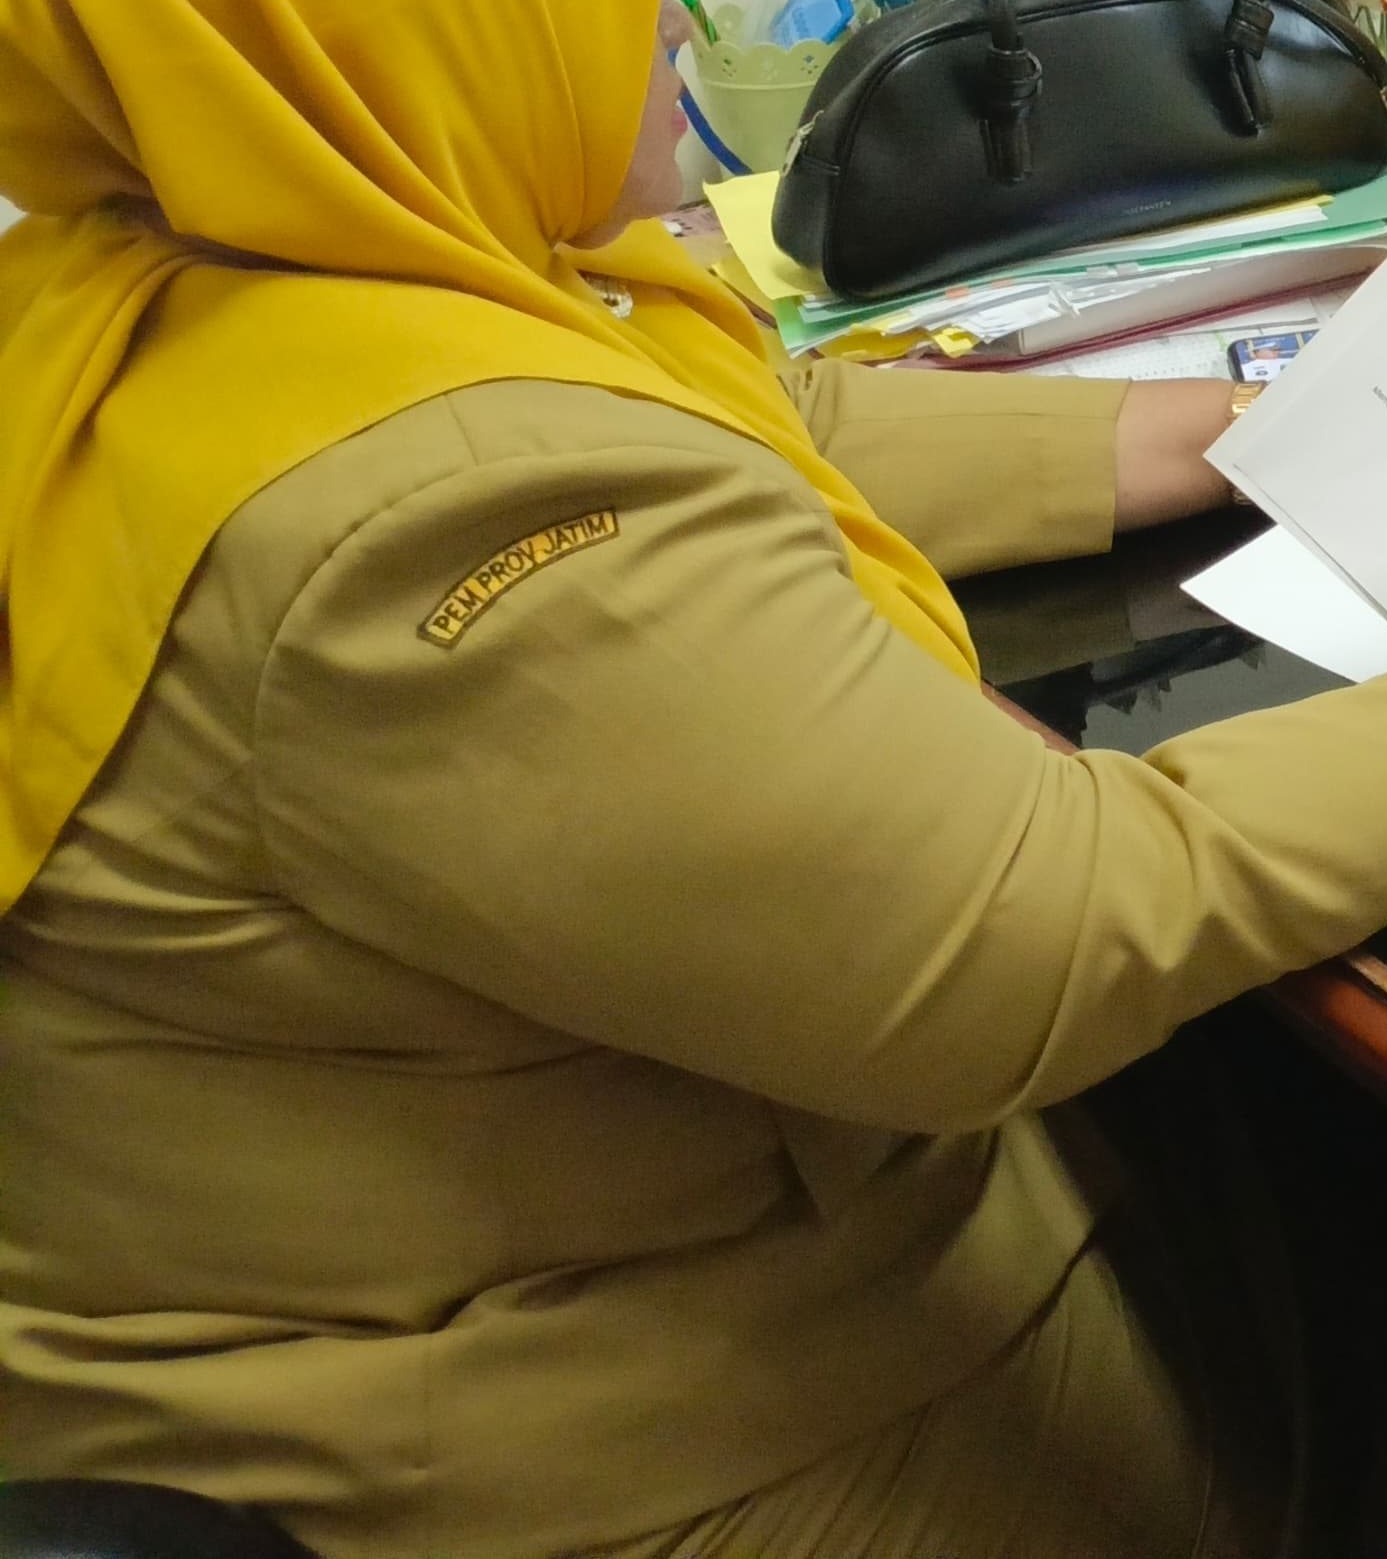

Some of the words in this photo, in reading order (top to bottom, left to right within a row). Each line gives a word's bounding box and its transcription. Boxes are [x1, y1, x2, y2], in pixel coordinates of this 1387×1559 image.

[433, 586, 483, 634] PEM
[477, 542, 538, 594] PROV
[543, 513, 608, 555] JATIM
